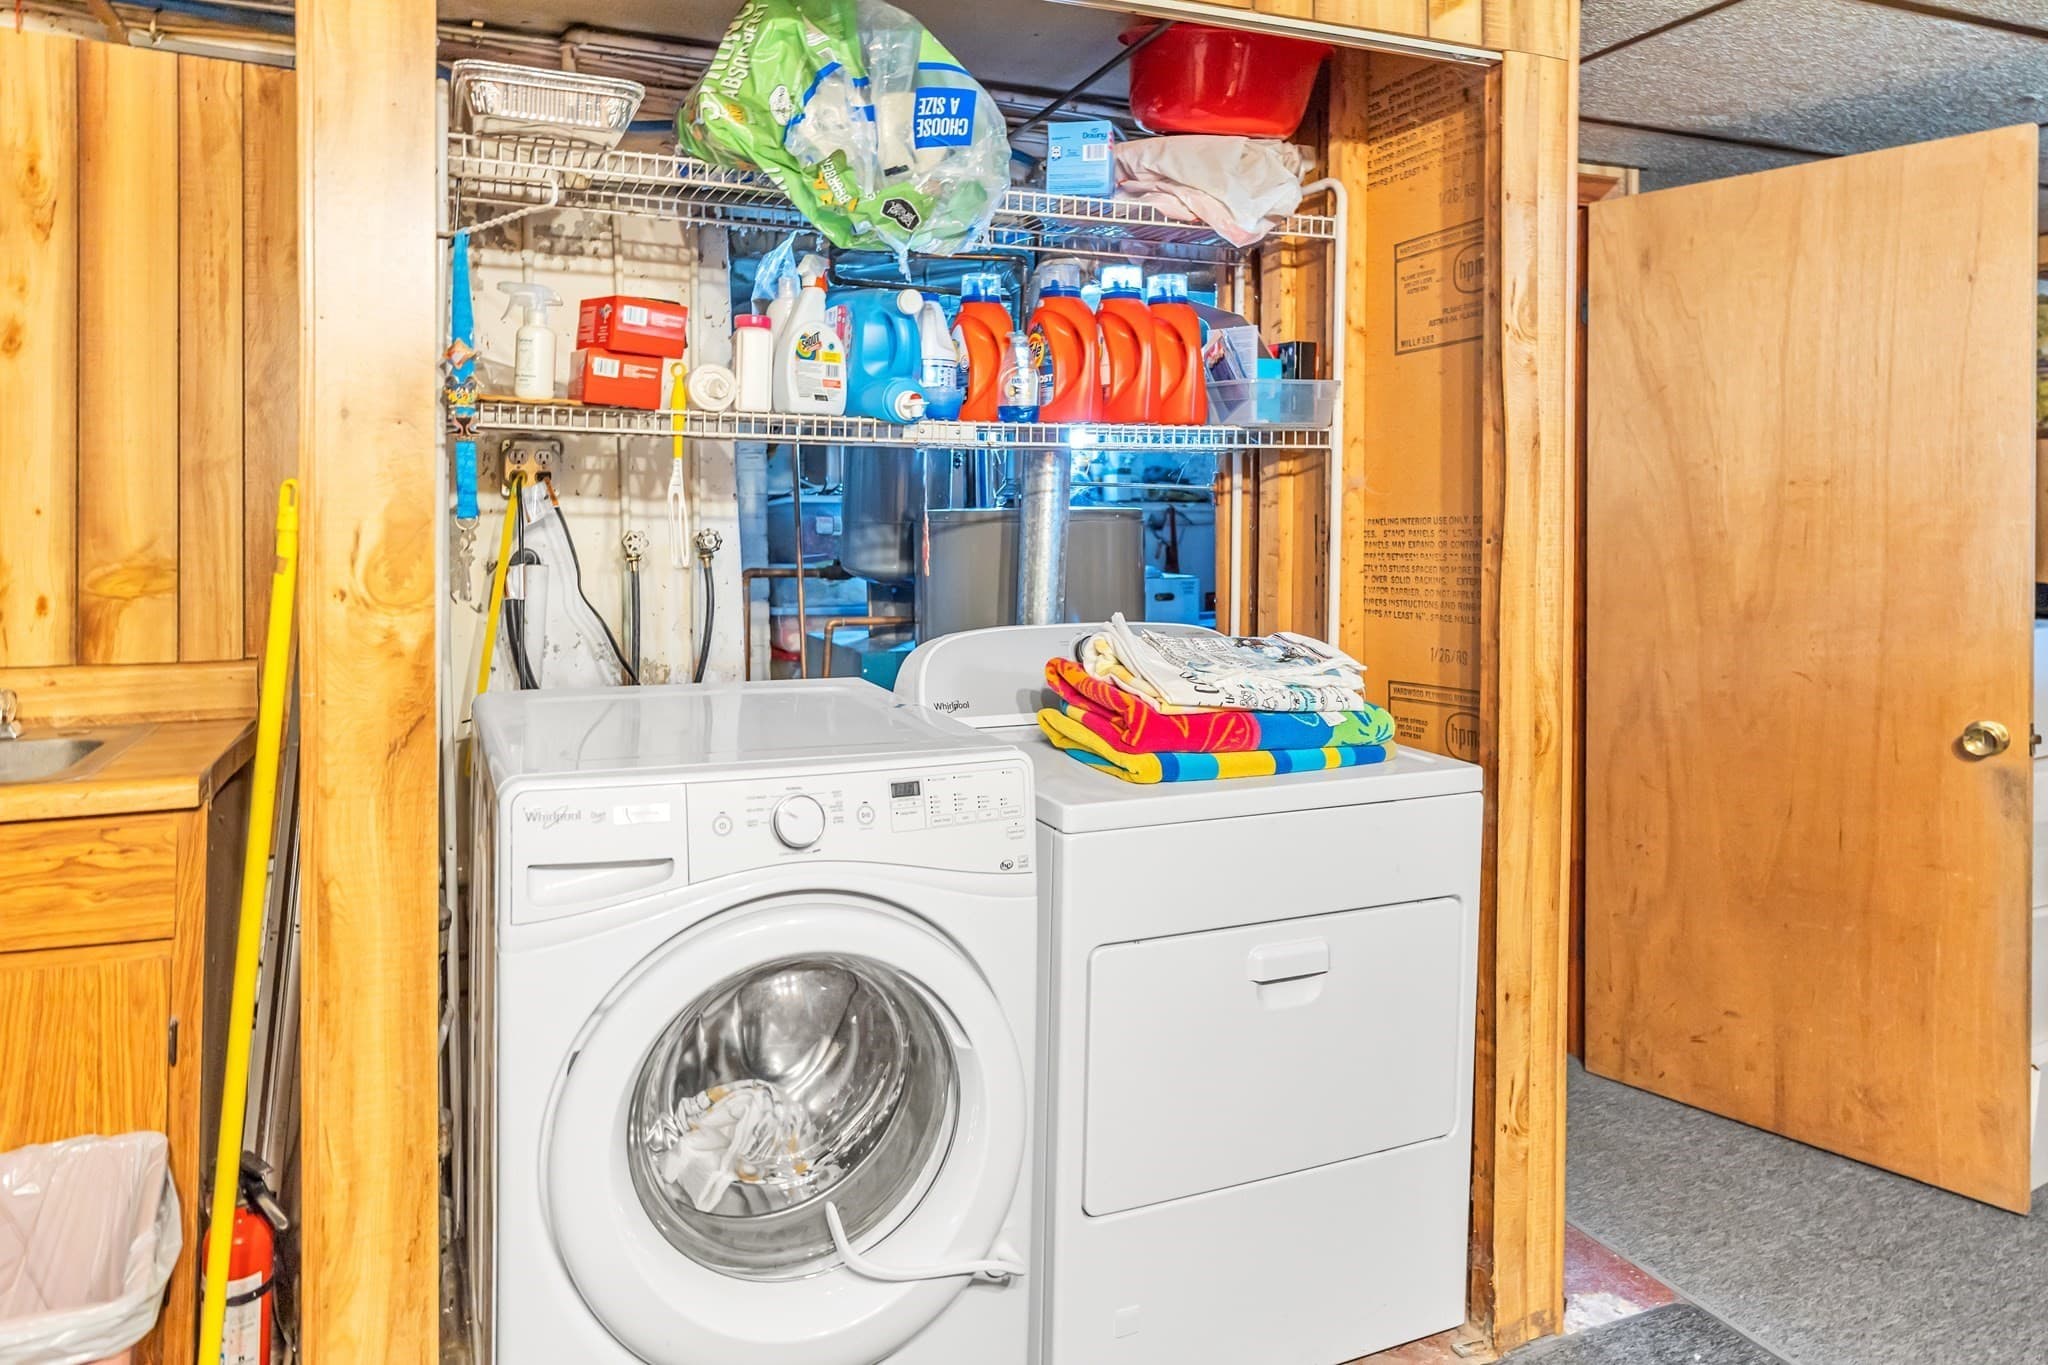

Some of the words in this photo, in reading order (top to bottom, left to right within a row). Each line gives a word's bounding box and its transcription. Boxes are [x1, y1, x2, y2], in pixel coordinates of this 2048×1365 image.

[917, 96, 947, 116] SIZE
[950, 97, 961, 115] A
[916, 117, 969, 138] CHOOSE
[1082, 131, 1107, 141] Downy
[1367, 517, 1399, 526] PANELING
[1400, 516, 1432, 526] INTERIOR
[1432, 515, 1448, 525] USE
[1407, 540, 1434, 549] EXPAND
[1388, 564, 1410, 573] STUDS
[1371, 575, 1387, 583] OVER
[1391, 575, 1411, 584] SOLID
[1389, 599, 1439, 609] INSTRUCTIONS
[1440, 601, 1456, 610] AND
[1393, 611, 1413, 620] LEAST
[933, 699, 970, 714] Whirlpool
[522, 804, 582, 830] Whirlpool
